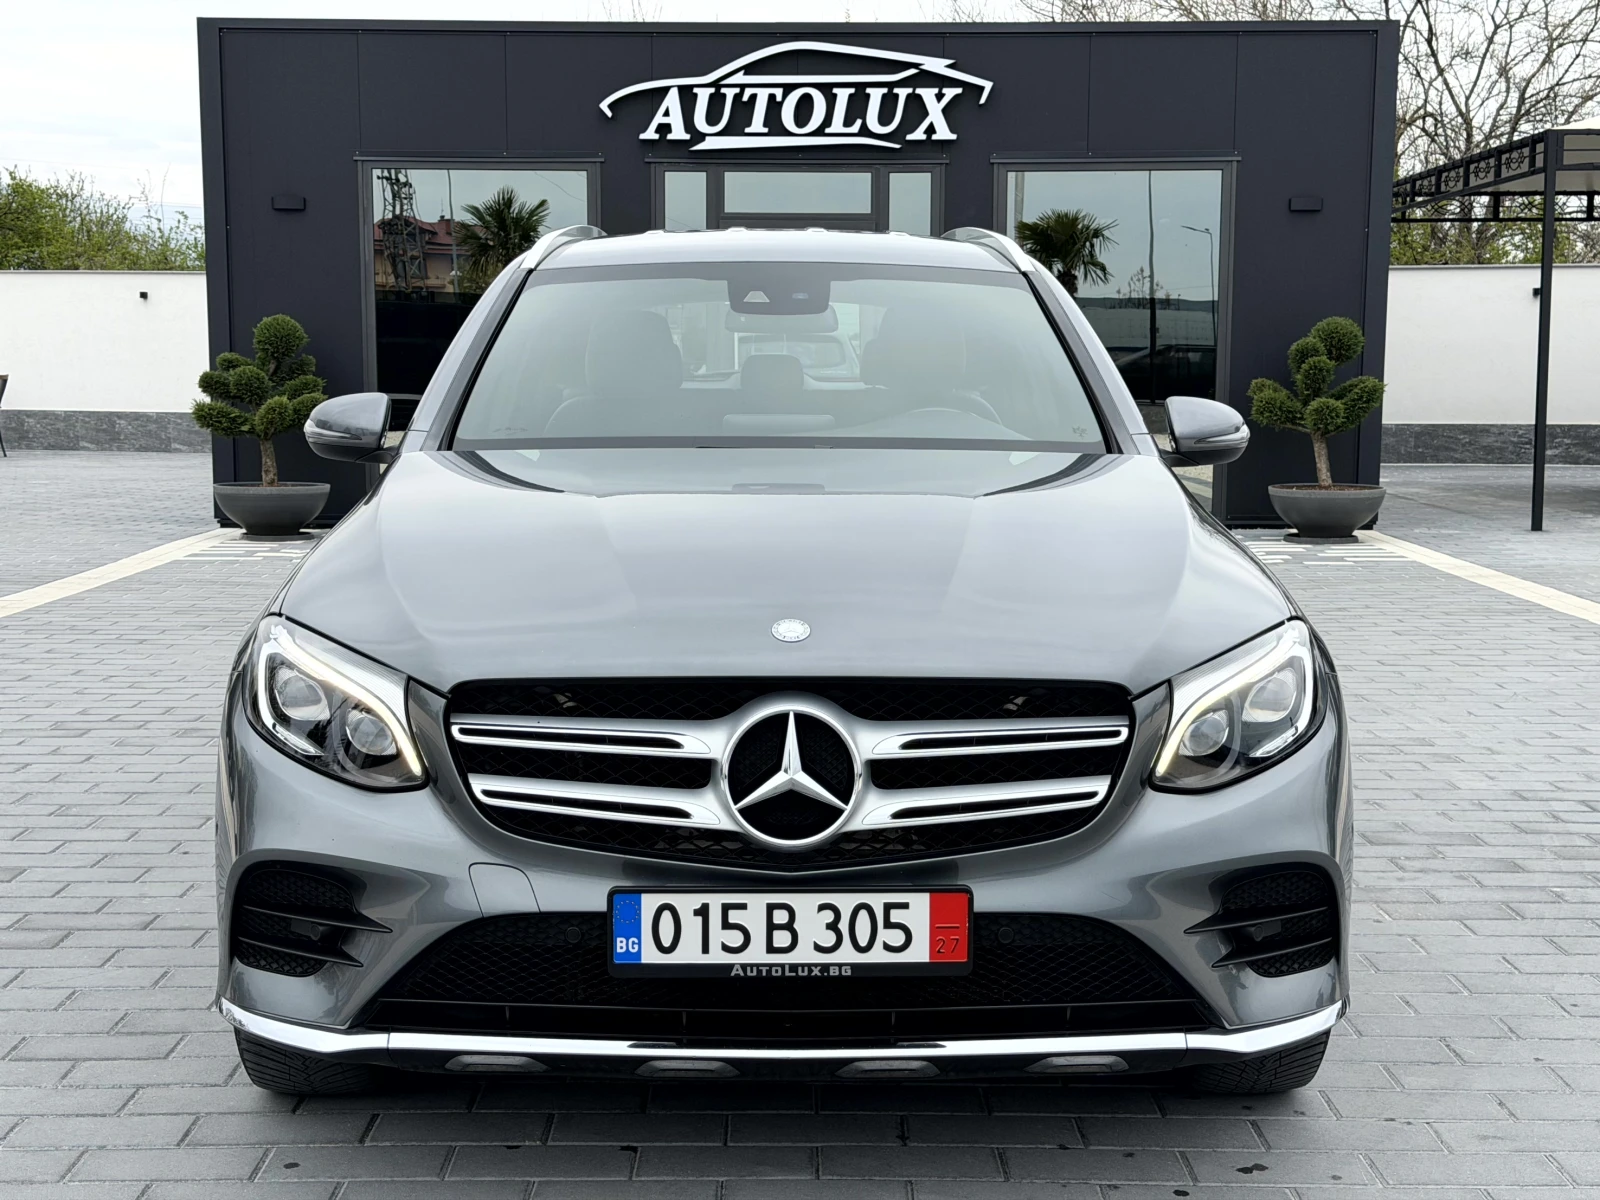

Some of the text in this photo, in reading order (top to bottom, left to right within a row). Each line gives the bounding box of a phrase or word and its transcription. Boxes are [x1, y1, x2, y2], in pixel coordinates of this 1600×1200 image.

[639, 86, 963, 140] AUTOLUX
[616, 937, 640, 953] BG
[651, 902, 914, 954] 015 B 305
[935, 936, 960, 954] 27
